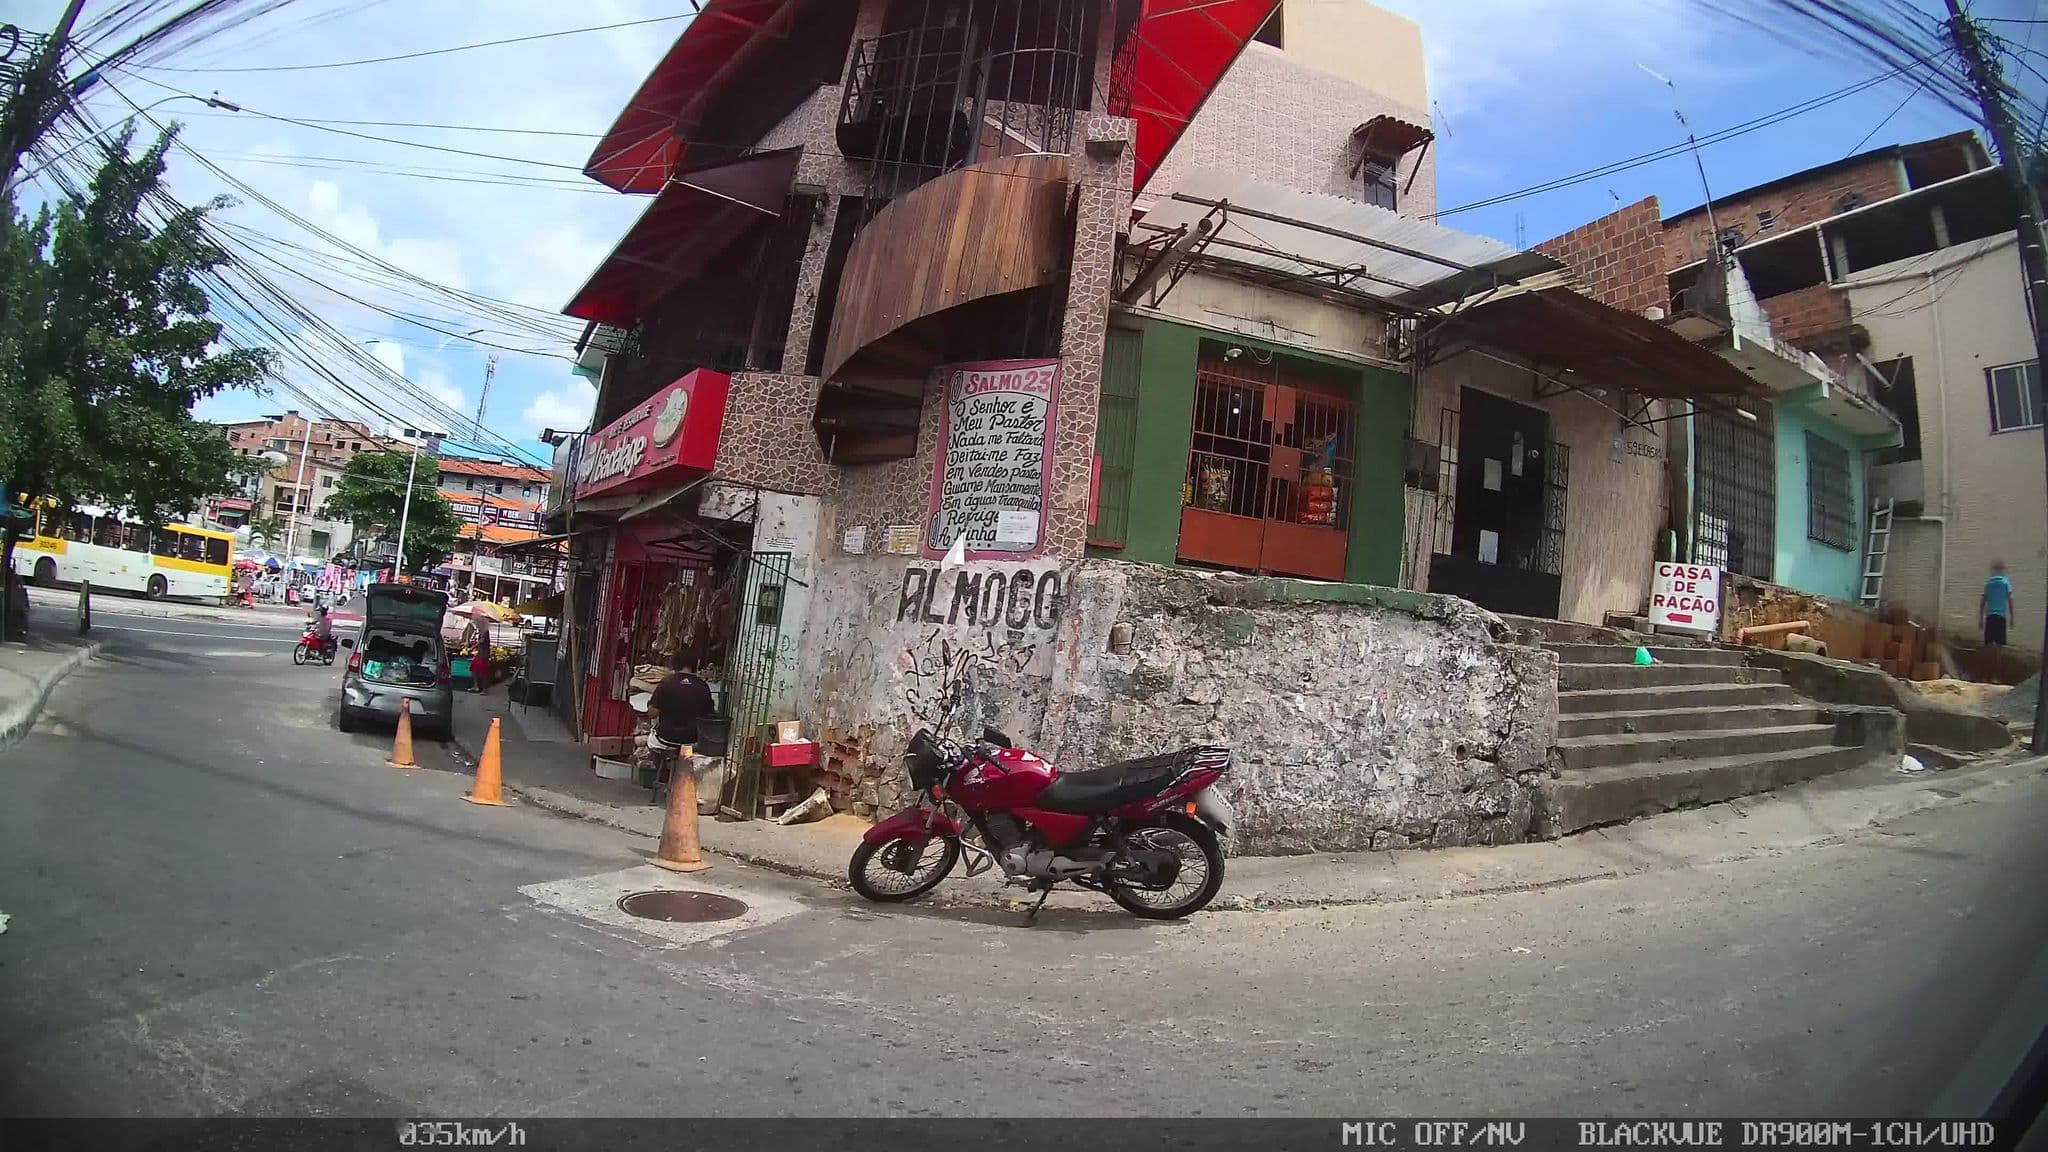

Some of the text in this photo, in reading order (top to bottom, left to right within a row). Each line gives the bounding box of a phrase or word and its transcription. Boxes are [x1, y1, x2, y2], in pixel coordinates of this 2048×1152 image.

[965, 370, 1053, 394] SALMO 23
[955, 396, 1035, 417] O Senhor é
[954, 413, 1043, 432] Meu Pastor
[949, 432, 985, 449] Nada
[988, 433, 1002, 445] me
[1014, 448, 1041, 468] Faz
[946, 466, 964, 481] em
[943, 496, 960, 510] Em
[964, 494, 997, 511] águas
[1659, 564, 1712, 580] CASA
[1674, 580, 1697, 593] DE
[1653, 594, 1715, 613] RAÇÃO
